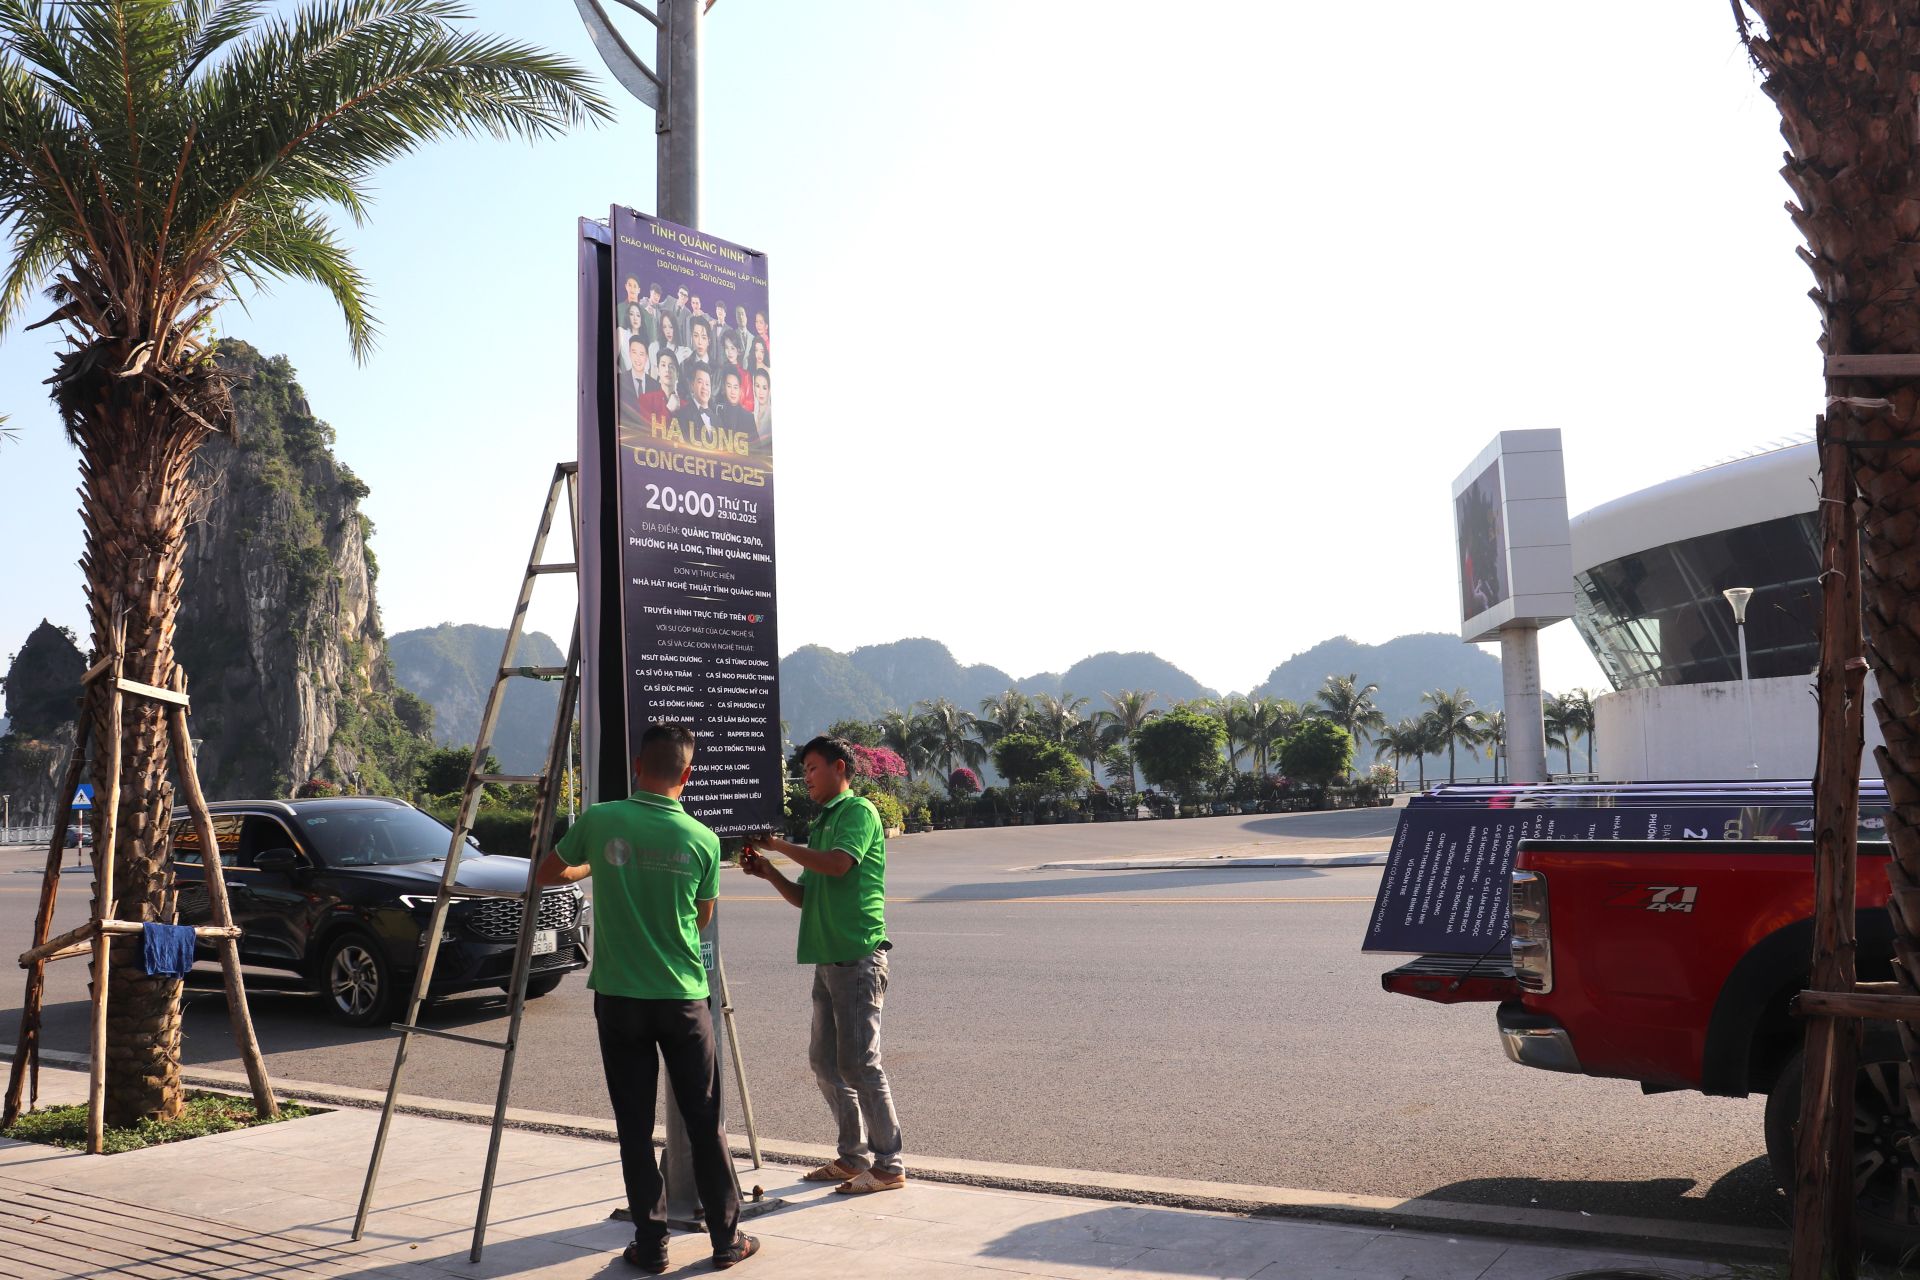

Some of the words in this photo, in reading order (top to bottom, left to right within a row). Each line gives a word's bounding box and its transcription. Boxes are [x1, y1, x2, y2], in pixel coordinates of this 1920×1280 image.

[650, 223, 676, 241] TỈNH
[679, 234, 717, 253] QUẢNG
[720, 246, 744, 263] NINH
[657, 259, 694, 277] (30/10/1963
[700, 272, 736, 290] 30/10/2025)
[651, 413, 684, 448] HẠ
[689, 421, 749, 456] LONG
[634, 447, 718, 478] CONCERT
[721, 462, 765, 487] 2025
[645, 483, 715, 518] 20:00
[717, 496, 740, 511] Thứ
[743, 500, 757, 513] Tư
[718, 511, 757, 524] 29.10.2025
[642, 521, 657, 532] ĐỊA
[681, 526, 709, 539] QUẢNG
[711, 530, 741, 543] TRƯỜNG
[743, 536, 763, 547] 30/10,
[630, 536, 665, 549] PHƯỜNG
[667, 543, 679, 553] HẠ
[681, 543, 704, 555] LONG,
[706, 545, 724, 557] TỈNH
[725, 549, 751, 560] QUẢNG
[753, 553, 772, 562] NINH.
[633, 577, 649, 586] NHÀ
[651, 578, 665, 587] HÁT
[667, 580, 687, 590] NGHỆ
[689, 583, 711, 592] THUẬT
[713, 584, 729, 594] TỈNH
[731, 586, 753, 597] QUẢNG
[755, 590, 771, 598] NINH
[643, 606, 672, 615] TRUYỀN
[674, 607, 692, 617] HÌNH
[693, 610, 711, 620] TRỰC
[713, 611, 727, 619] TIẾP
[729, 613, 746, 621] TRÊN
[664, 670, 673, 678] HẠ
[675, 670, 692, 678] TRÂM
[758, 674, 774, 682] THỊNH
[750, 687, 758, 695] MỸ
[666, 714, 679, 722] BẢO
[738, 715, 750, 723] BẢO
[724, 744, 744, 752] TRỐNG
[699, 765, 709, 773] ĐẠI
[704, 808, 721, 816] ĐOÀN
